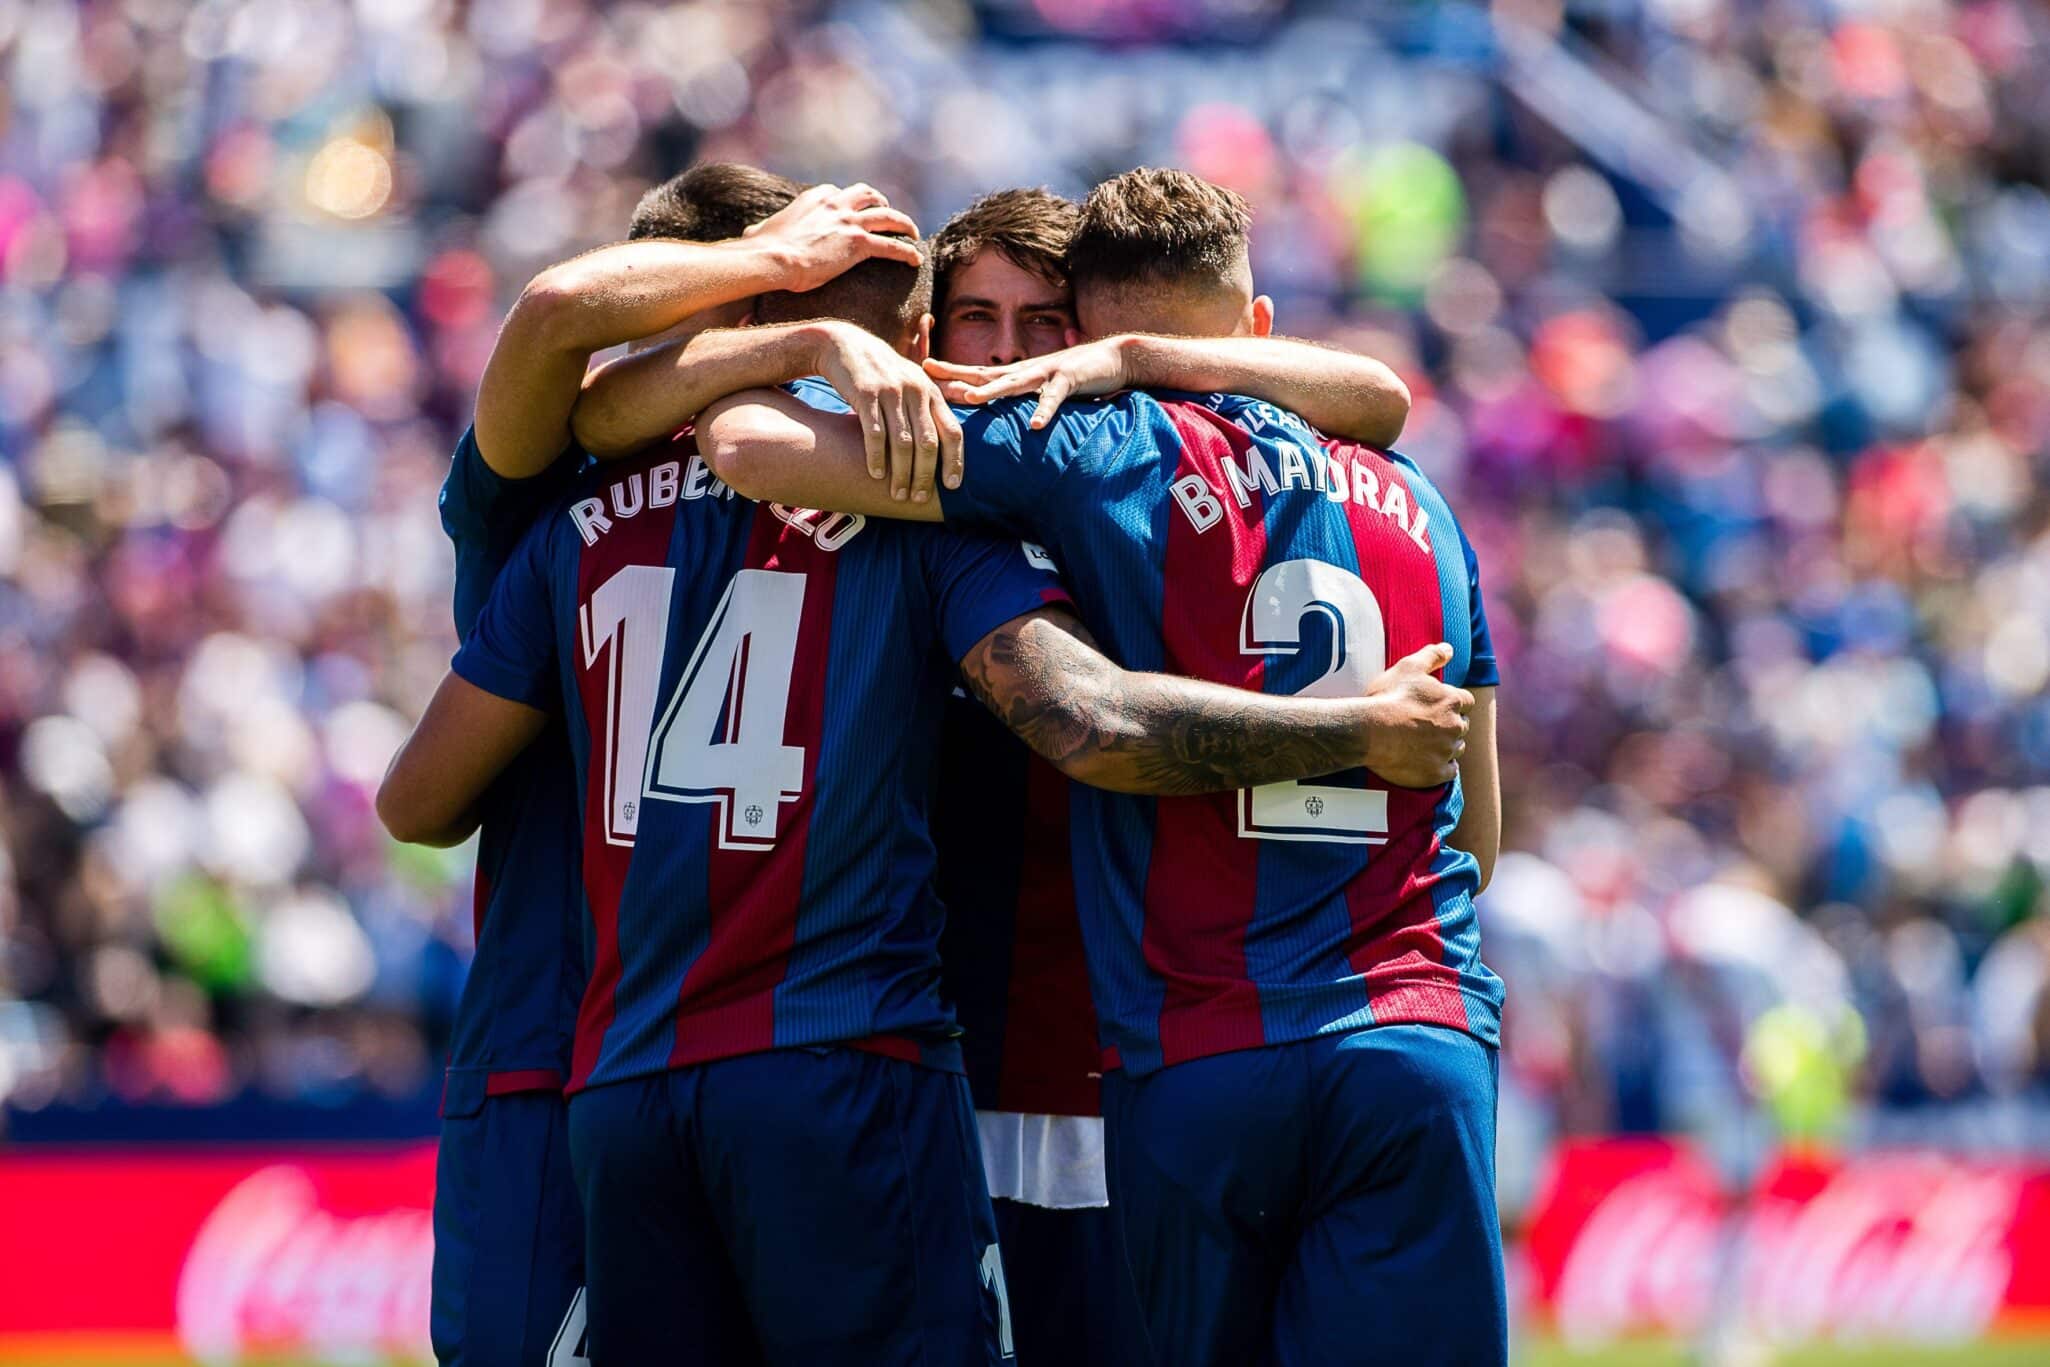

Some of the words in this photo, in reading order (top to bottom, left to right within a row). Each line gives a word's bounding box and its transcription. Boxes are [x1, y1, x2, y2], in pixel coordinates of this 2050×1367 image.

[1170, 473, 1225, 534] B
[1220, 437, 1430, 554] MAYORAL
[579, 564, 808, 852] 14
[1237, 558, 1389, 846] 2
[979, 1242, 1015, 1360] 1
